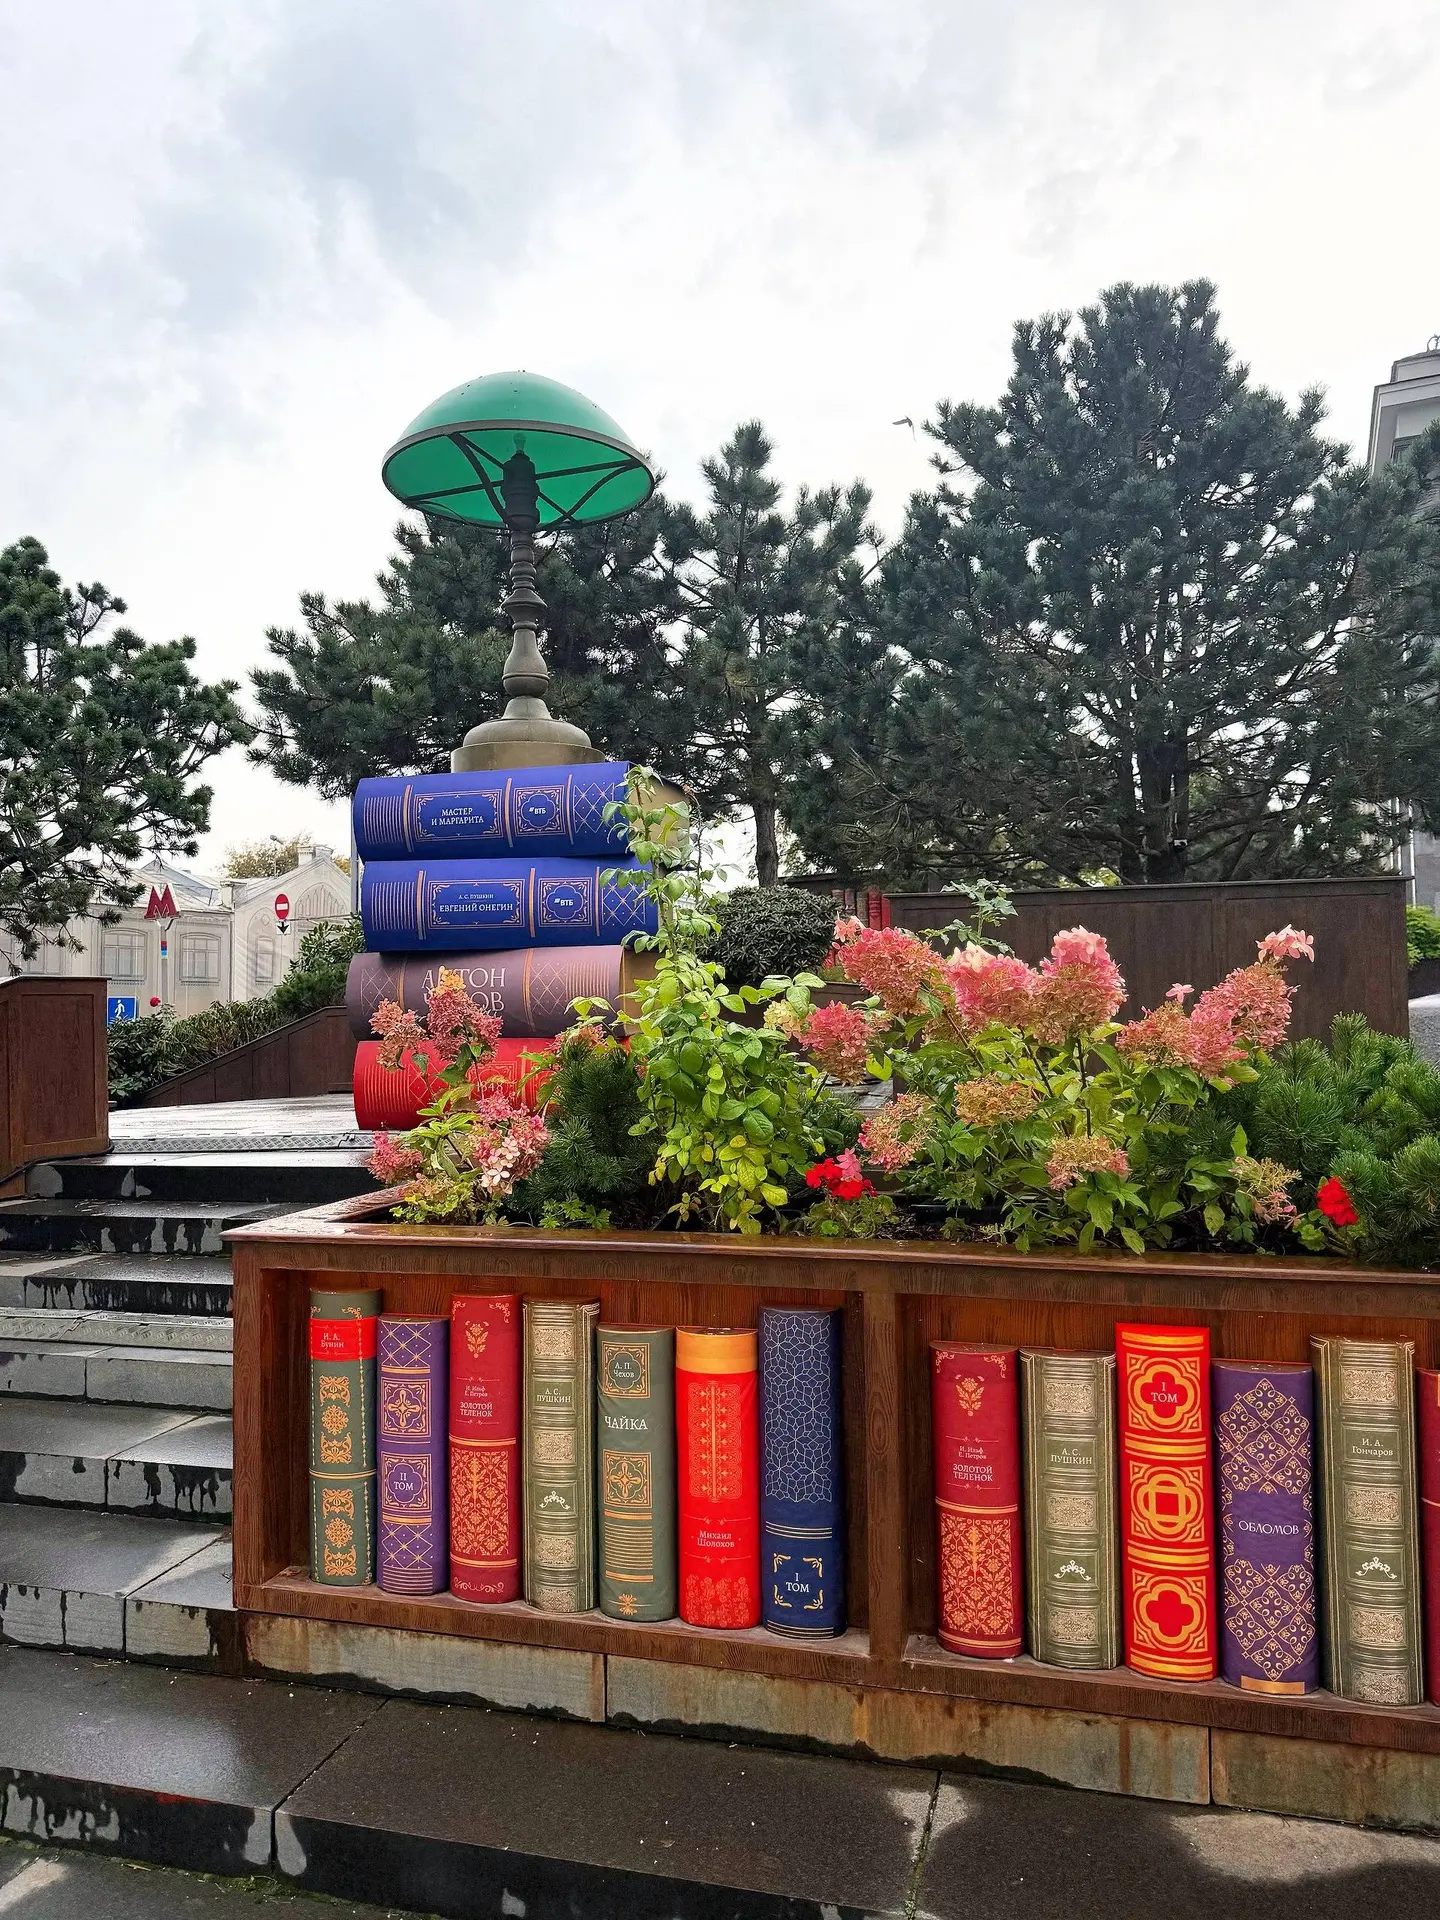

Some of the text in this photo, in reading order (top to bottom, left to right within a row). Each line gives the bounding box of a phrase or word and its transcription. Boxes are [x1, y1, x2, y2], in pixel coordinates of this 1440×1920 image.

[441, 807, 473, 817] МАСТЕР
[534, 807, 547, 815] ВТБ
[431, 816, 485, 826] И МАРГАРИТА
[439, 902, 513, 912] ЕВГЕНИЙ ОНЕГИН
[321, 1340, 344, 1350] Бунин
[624, 1362, 632, 1370] П.
[613, 1369, 635, 1378] Чехов
[1161, 1381, 1166, 1391] I
[553, 1388, 561, 1396] С.
[536, 1394, 571, 1403] ПУШКИН
[1150, 1392, 1178, 1403] ТОМ
[460, 1401, 493, 1410] ЗОЛОТОЙ
[460, 1408, 493, 1417] ТЕЛЕНОК
[604, 1415, 648, 1430] ЧАЙКА
[1361, 1438, 1384, 1447] И. А.
[965, 1452, 987, 1460] Петров
[1061, 1448, 1081, 1456] А. С.
[1352, 1445, 1394, 1458] Гончаров
[1050, 1454, 1092, 1465] ПУШКИН
[952, 1463, 993, 1474] ЗОЛОТОЙ
[952, 1471, 993, 1482] ТЕЛЕНОК
[393, 1481, 414, 1491] ТОМ
[1238, 1520, 1300, 1535] ОБЛОМОВ
[699, 1529, 732, 1540] Михаил
[697, 1537, 735, 1548] Шолохов
[795, 1572, 799, 1581] I
[785, 1581, 810, 1593] ТОМ
